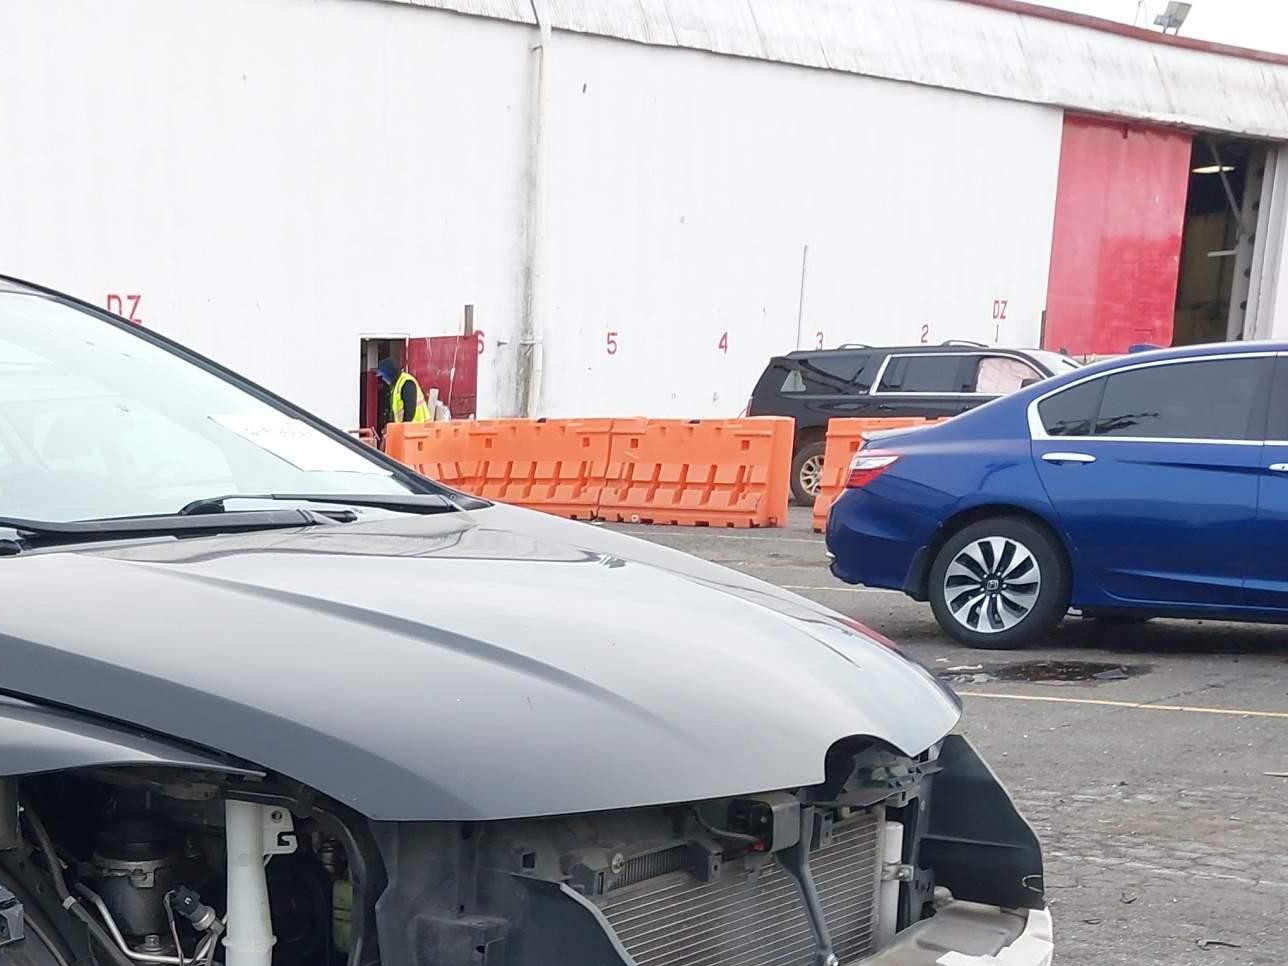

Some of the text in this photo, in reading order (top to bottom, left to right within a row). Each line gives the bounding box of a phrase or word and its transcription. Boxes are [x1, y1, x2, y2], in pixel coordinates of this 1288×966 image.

[992, 300, 1008, 320] DZ
[606, 331, 618, 355] 5
[718, 331, 728, 354] 4
[816, 332, 824, 350] 3
[920, 324, 930, 344] 2
